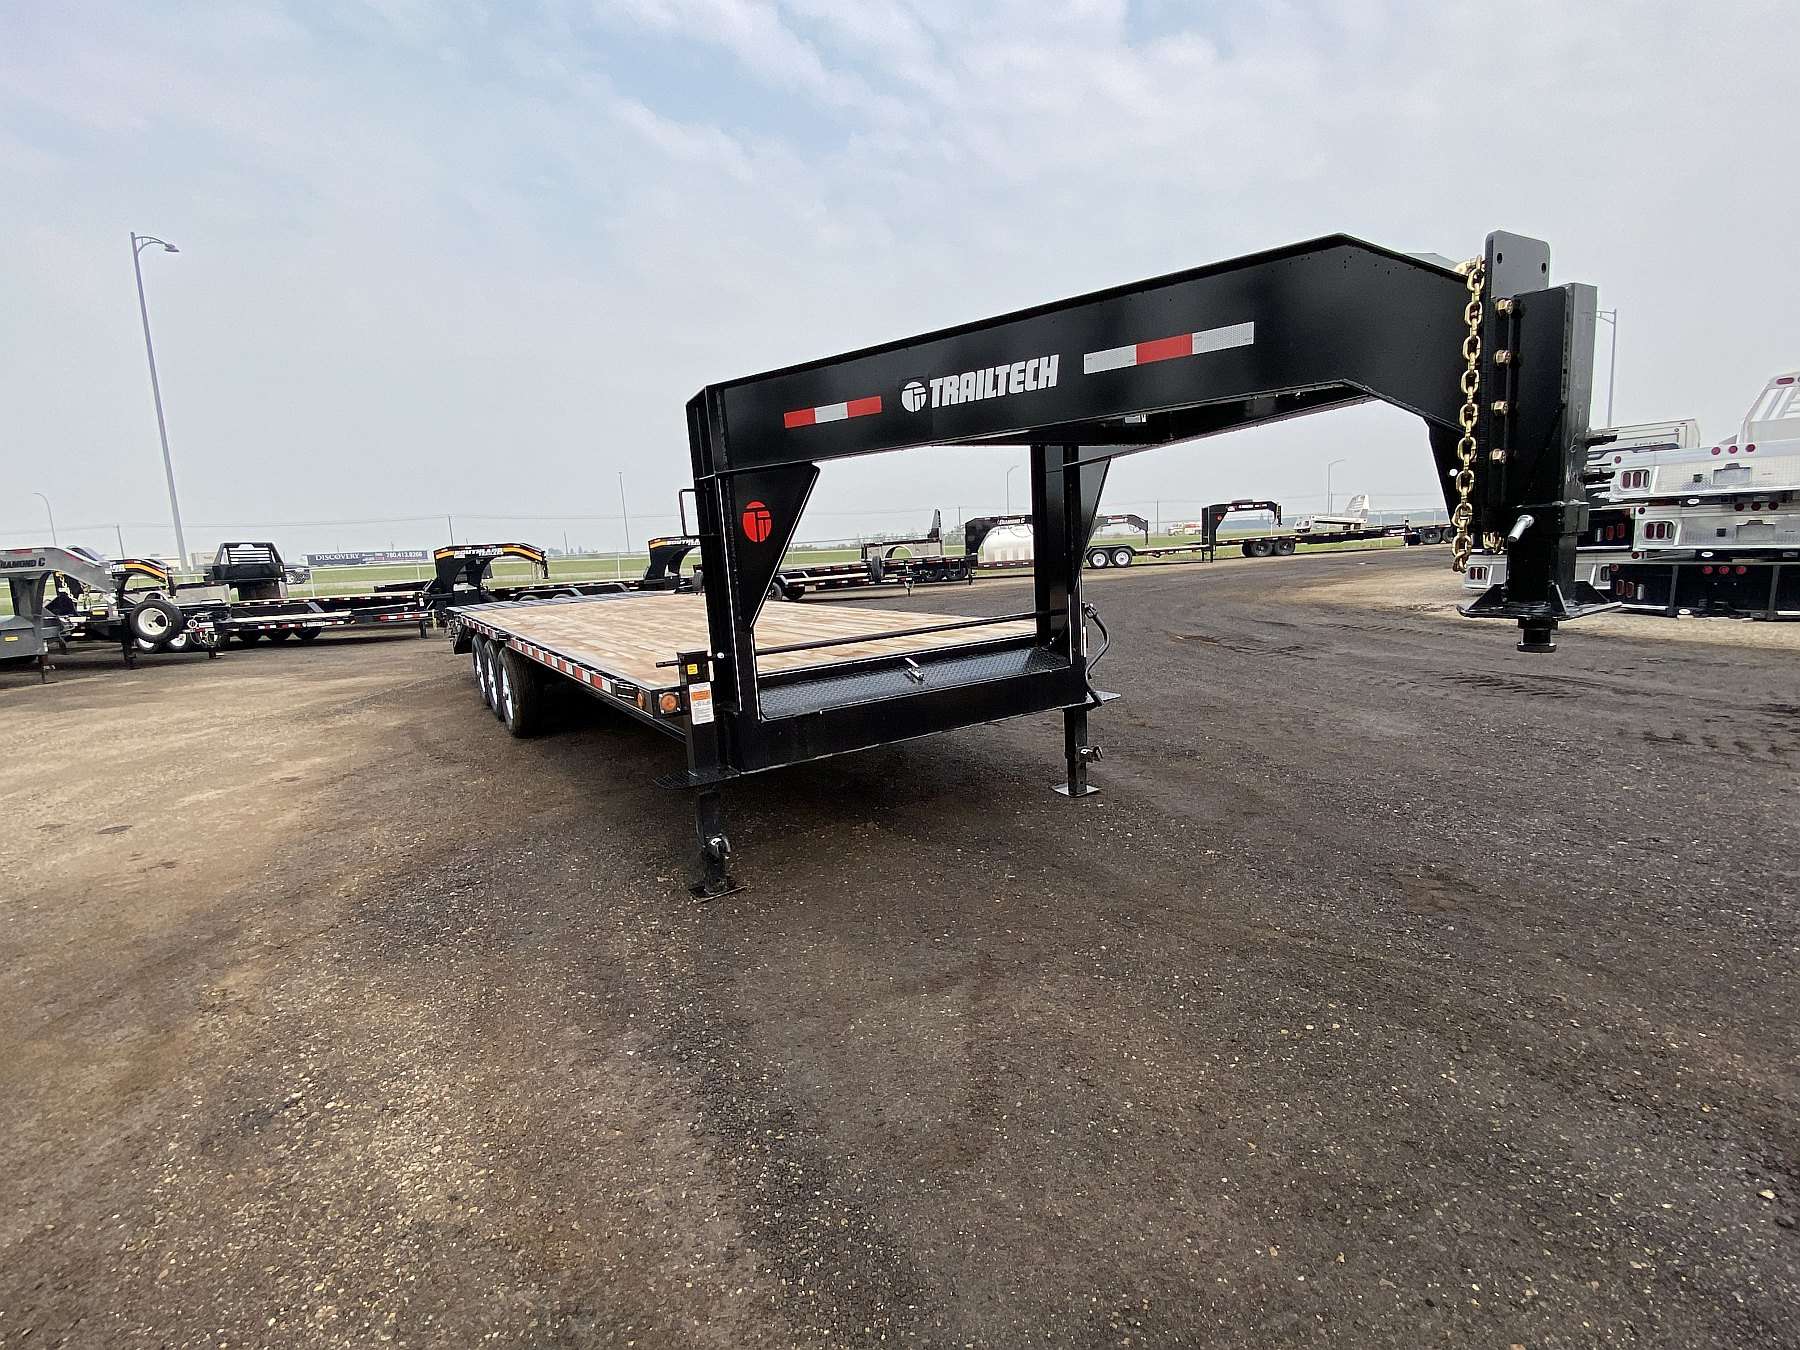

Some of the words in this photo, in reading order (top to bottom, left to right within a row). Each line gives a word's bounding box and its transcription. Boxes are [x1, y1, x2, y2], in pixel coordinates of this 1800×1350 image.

[929, 354, 1060, 408] TRAILTECH
[38, 557, 46, 567] C
[315, 553, 360, 561] DISCOVERY
